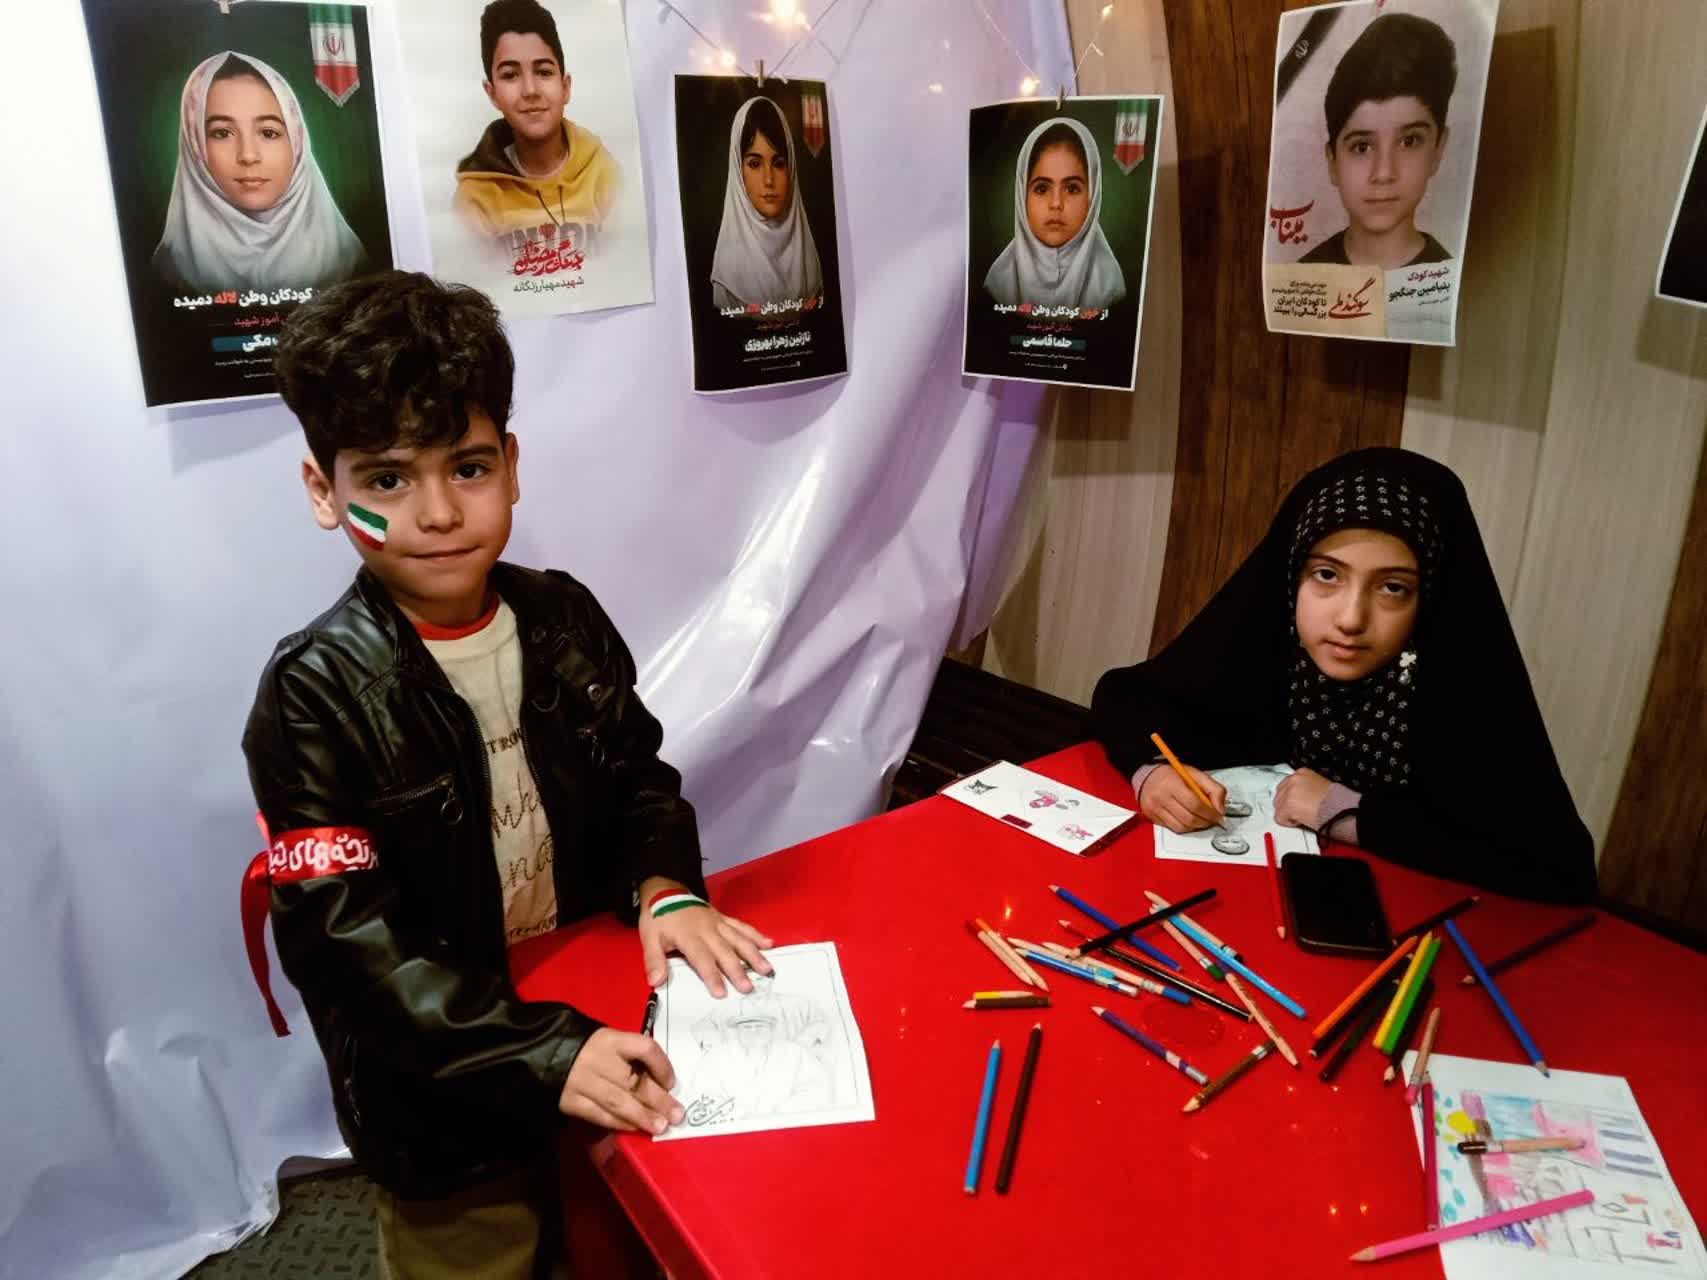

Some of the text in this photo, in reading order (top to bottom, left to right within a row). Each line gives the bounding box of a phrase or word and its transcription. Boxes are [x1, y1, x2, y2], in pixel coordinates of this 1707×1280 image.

[1428, 266, 1449, 279] شهید
[560, 275, 584, 289] شهید
[173, 287, 313, 309] کودکان وطن لاله دمیده
[720, 305, 745, 318] دمیده
[760, 301, 778, 315] وطن
[779, 298, 803, 313] کودکان
[993, 303, 1017, 314] دمیده
[1032, 305, 1051, 317] وطن
[1051, 306, 1080, 319] کودکان
[1100, 309, 1109, 320] از
[242, 333, 272, 352] مکی
[1022, 334, 1053, 348] قاسمی
